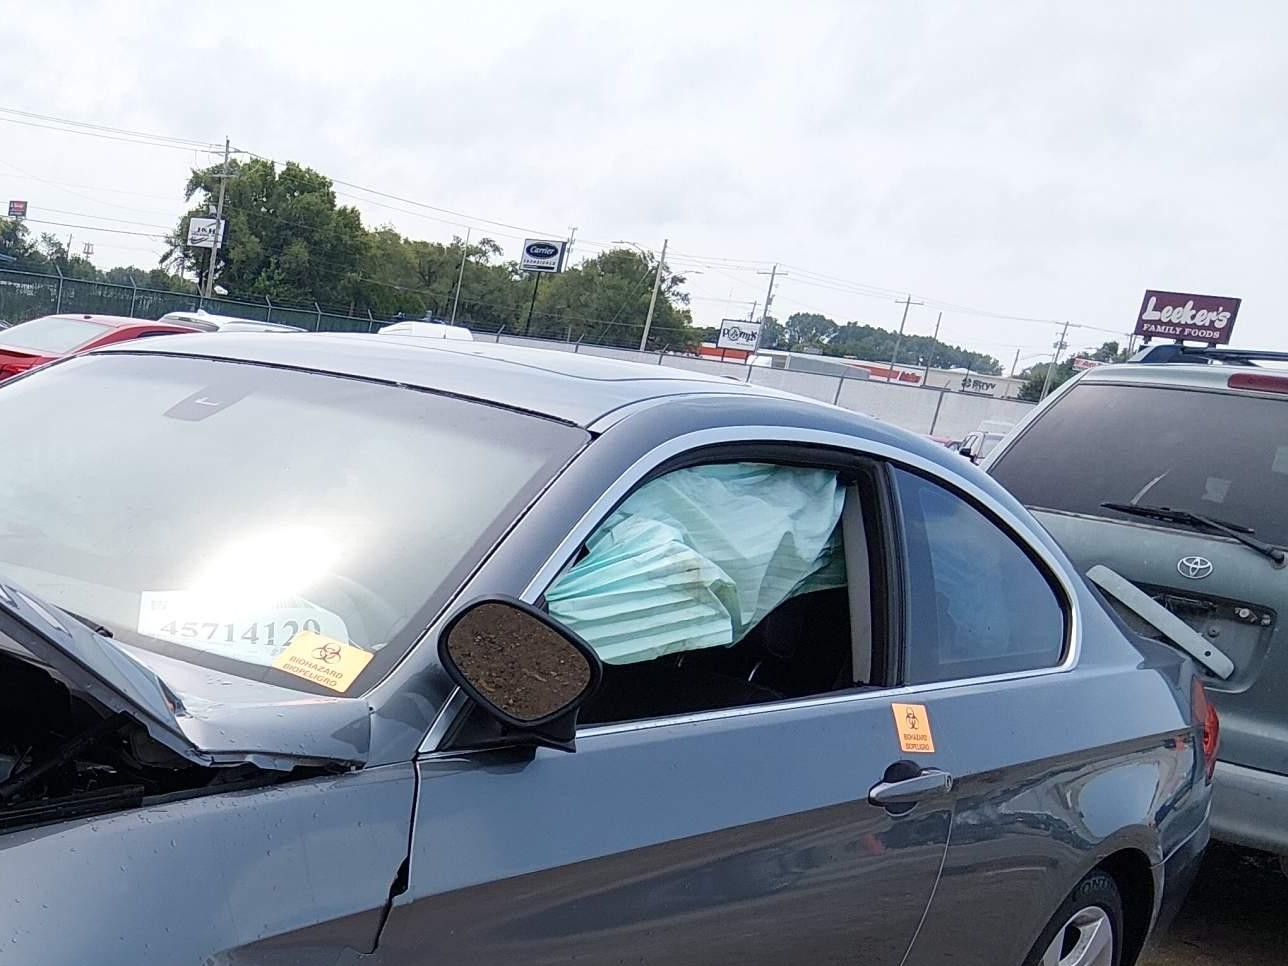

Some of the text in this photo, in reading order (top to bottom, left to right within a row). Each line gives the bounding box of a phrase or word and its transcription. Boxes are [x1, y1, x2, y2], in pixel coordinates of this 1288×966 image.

[529, 245, 555, 256] Carrier
[1142, 296, 1231, 328] Leeker's
[1142, 323, 1221, 339] FAMILY FOODS
[282, 663, 337, 687] BIOPELIGRO
[289, 655, 344, 680] BIOHAZARD
